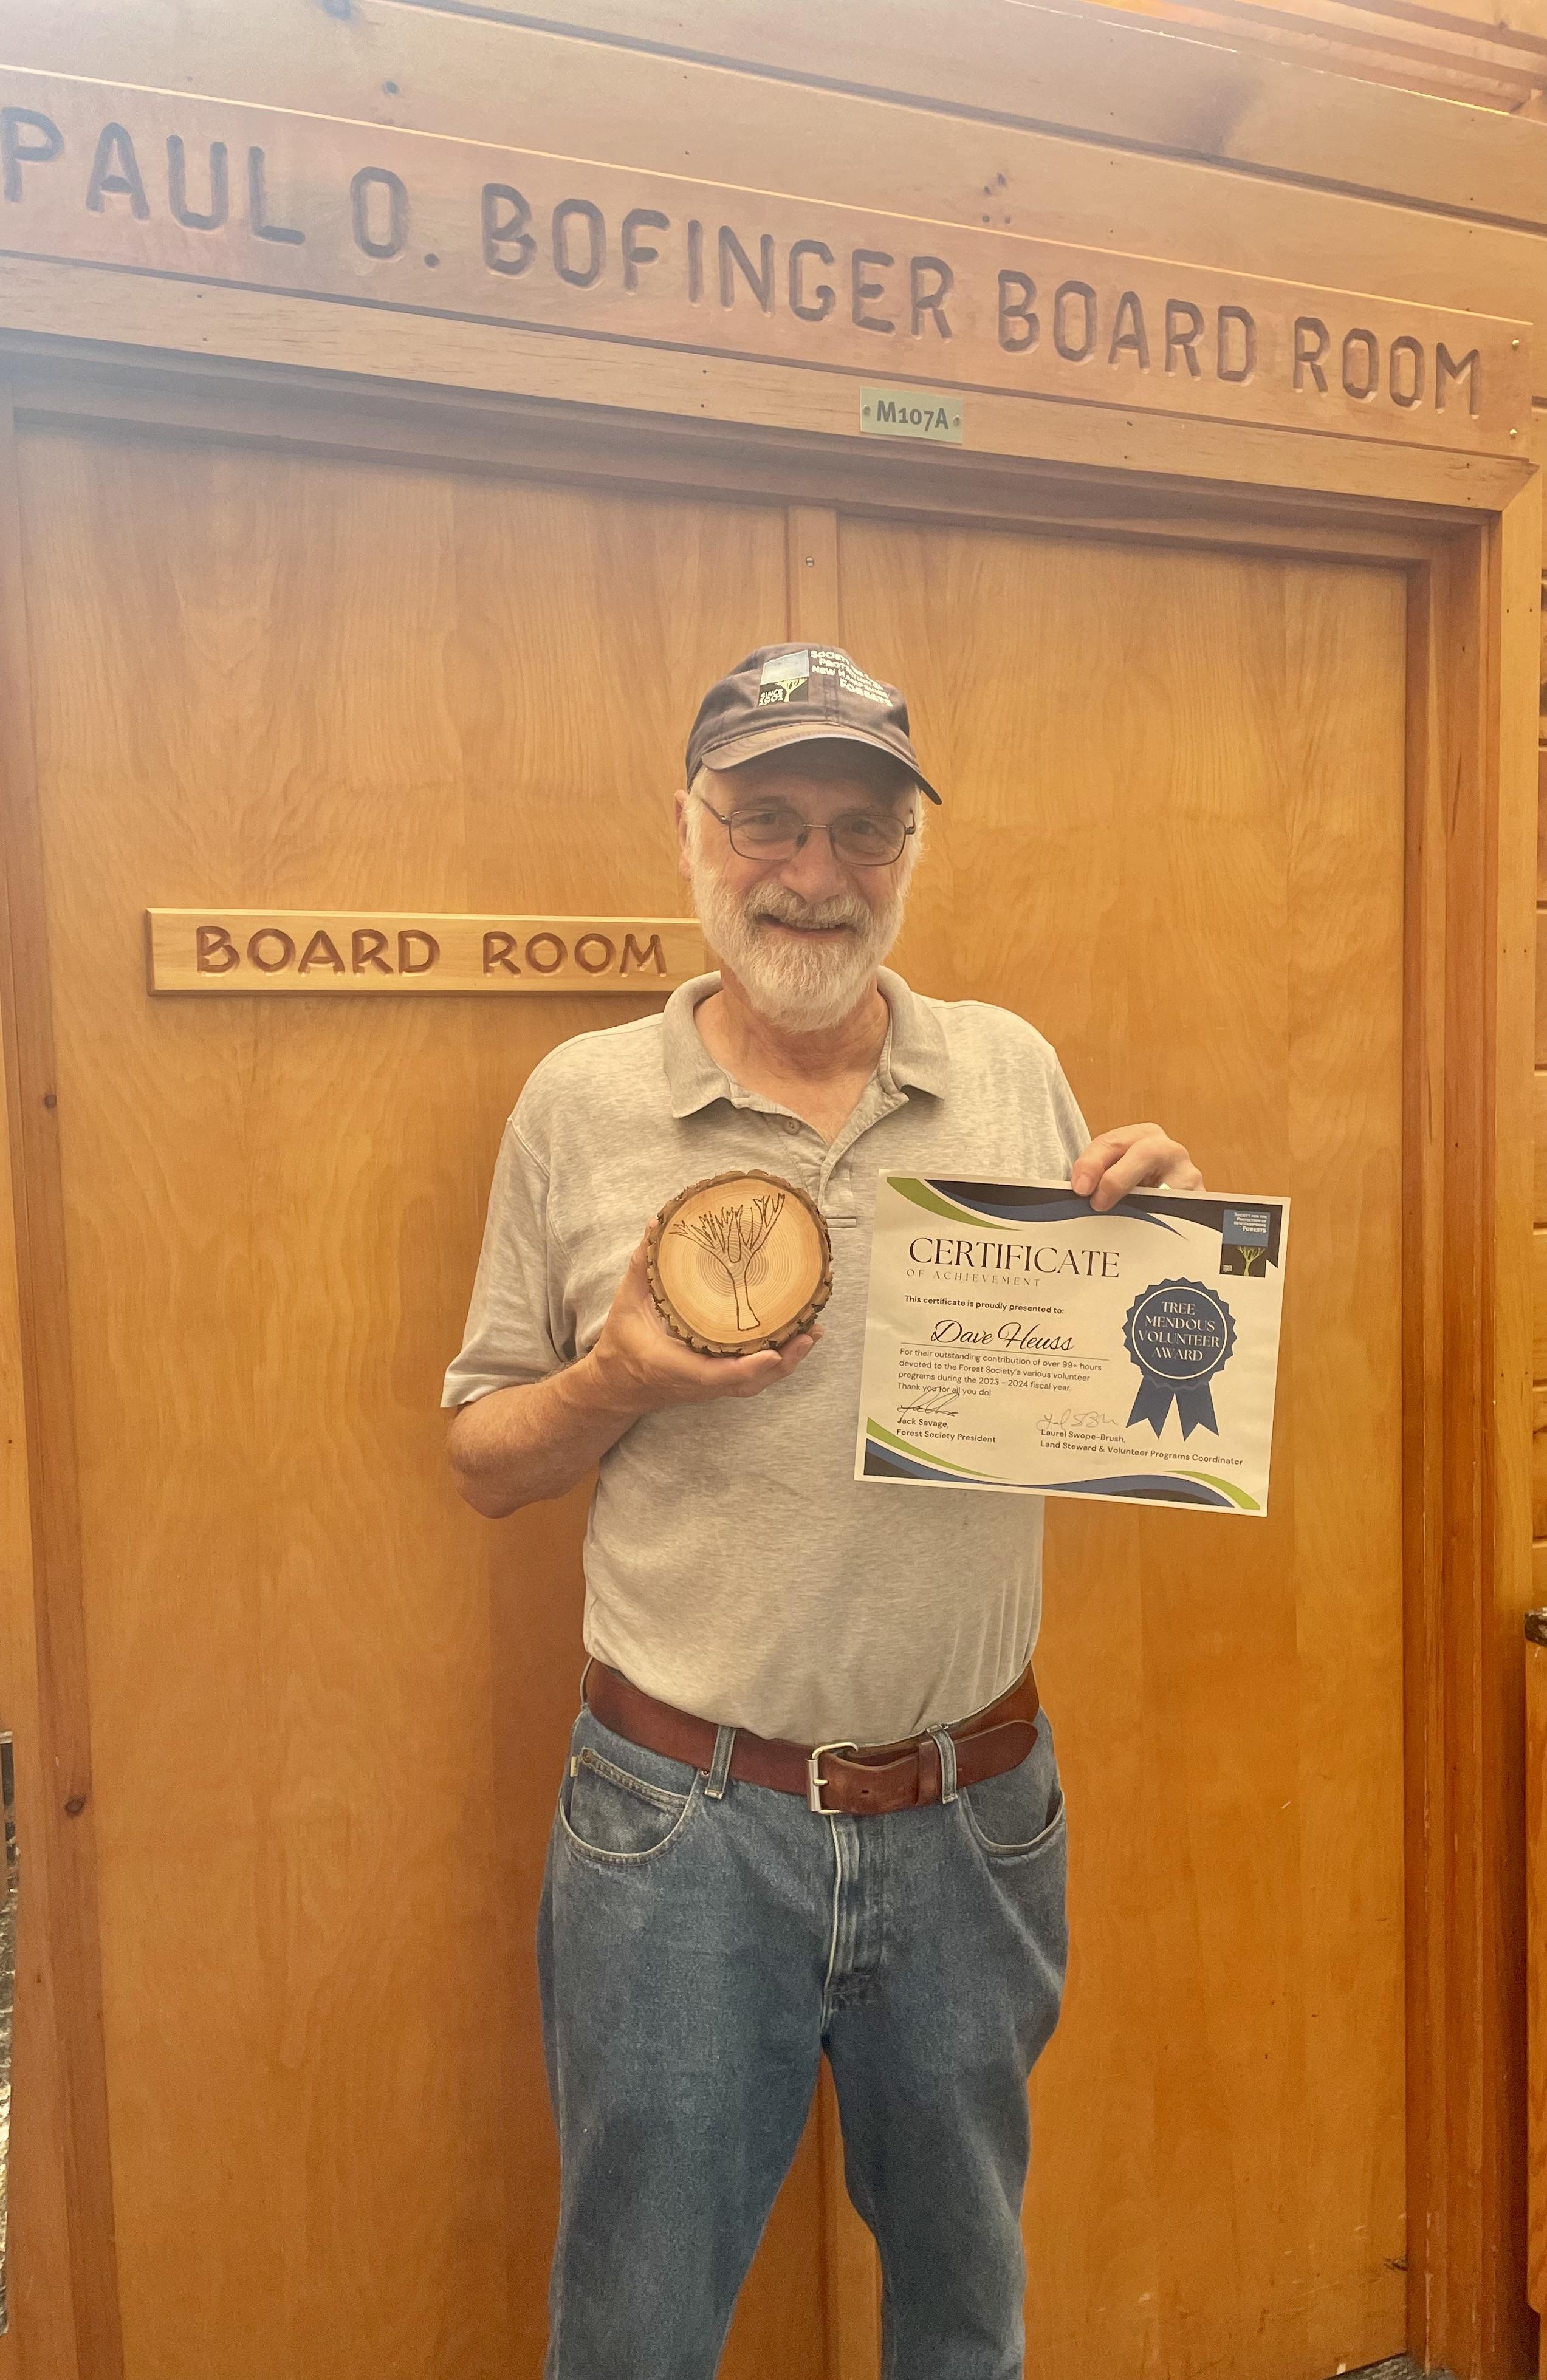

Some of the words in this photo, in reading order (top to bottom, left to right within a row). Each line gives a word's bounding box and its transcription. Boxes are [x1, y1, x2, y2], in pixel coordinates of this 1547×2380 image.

[1, 106, 306, 245] PAUL
[349, 166, 441, 269] O.
[481, 182, 955, 341] BOFINGER
[997, 268, 1257, 386] BOARD
[1292, 316, 1481, 420] ROOM
[876, 400, 949, 432] M107A
[812, 665, 836, 676] NEW
[196, 925, 441, 977] BOARD
[482, 931, 668, 978] ROOM
[909, 1237, 1120, 1278] CERTIFICATE
[906, 1268, 925, 1278] OF
[933, 1270, 1041, 1287] ACHIEVEMENT
[904, 1294, 921, 1304] This
[922, 1296, 966, 1307] certificate
[967, 1299, 975, 1307] is
[975, 1300, 1008, 1311] proudly
[1009, 1303, 1052, 1313] presented
[1053, 1306, 1065, 1315] to:
[1161, 1301, 1196, 1316] TREE
[1145, 1315, 1216, 1333] MENDOUS
[930, 1319, 995, 1345] Dave
[997, 1322, 1075, 1351] Heuss
[1138, 1329, 1220, 1349] VOLUNTEER
[900, 1347, 913, 1356] For
[914, 1349, 933, 1358] their
[934, 1351, 981, 1363] outstanding
[983, 1355, 1031, 1366] contribution
[1080, 1363, 1102, 1371] hours
[1151, 1346, 1204, 1362] AWARD
[899, 1359, 932, 1369] devoted
[944, 1363, 957, 1371] the
[959, 1364, 984, 1373] Forest
[986, 1366, 1021, 1377] Society's
[1023, 1369, 1051, 1378] various
[1053, 1372, 1091, 1382] volunteer
[897, 1381, 921, 1391] Thank
[898, 1372, 936, 1381] programs
[937, 1373, 962, 1384] during
[978, 1376, 1000, 1386] 2023
[1007, 1379, 1029, 1388] 2024
[1030, 1381, 1051, 1390] fiscal
[918, 1418, 950, 1429] Savage,
[1041, 1428, 1067, 1438] Laurel
[896, 1428, 923, 1438] Forest
[924, 1431, 956, 1442] Society
[956, 1433, 996, 1443] President
[1040, 1440, 1061, 1449] Land
[1062, 1441, 1097, 1452] Steward
[1106, 1446, 1149, 1457] Volunteer
[1150, 1449, 1190, 1461] Programs
[1191, 1453, 1244, 1466] Coordinator
